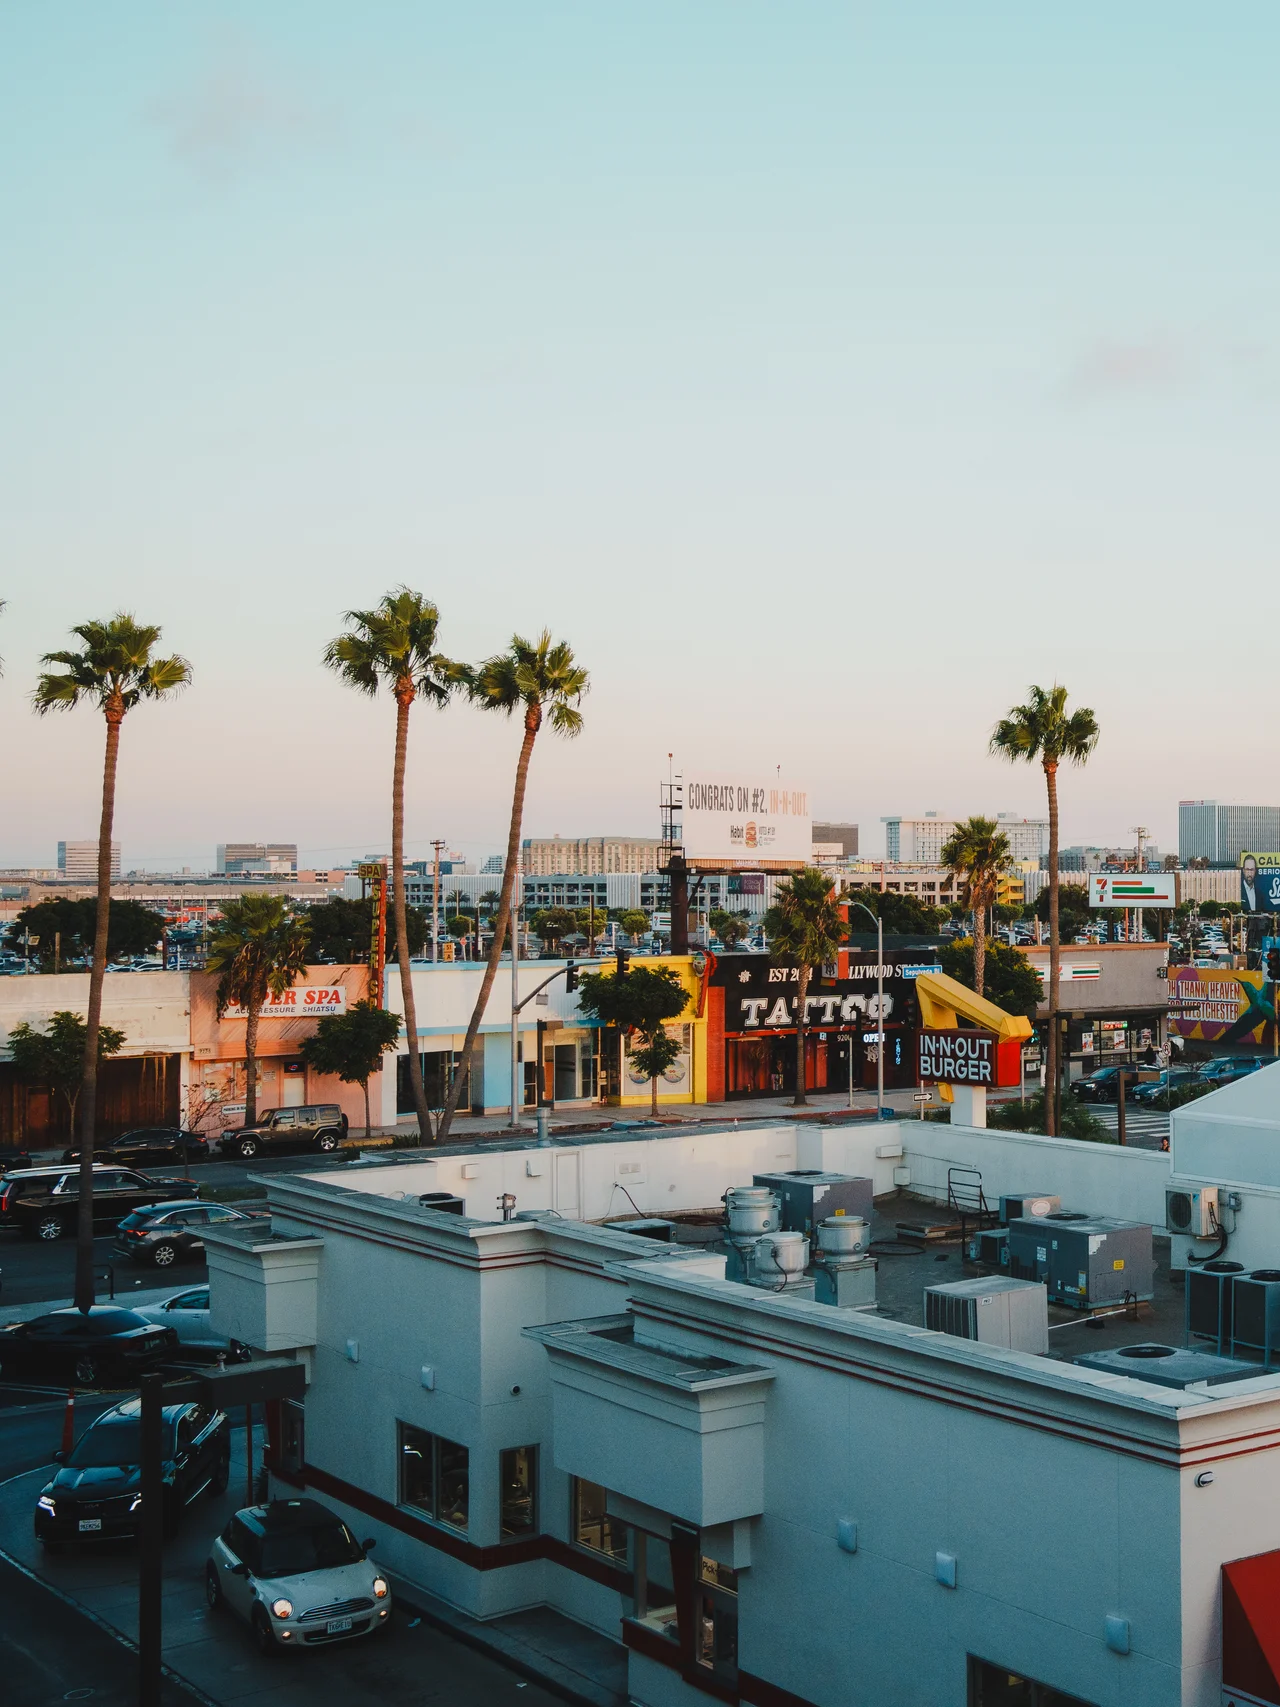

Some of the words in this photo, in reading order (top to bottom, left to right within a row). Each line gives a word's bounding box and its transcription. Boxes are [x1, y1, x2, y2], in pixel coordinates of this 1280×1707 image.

[688, 783, 734, 812] CONGRATS
[737, 786, 749, 813] ON
[751, 788, 768, 816] #2,
[359, 865, 380, 877] SPA
[768, 968, 789, 982] EST
[905, 968, 933, 978] Sepulveda
[304, 989, 342, 1005] SPA
[1179, 980, 1207, 1000] THANK
[1209, 981, 1240, 1001] HEAVEN
[740, 992, 894, 1027] TATTOO
[1183, 1000, 1240, 1021] WESTCHESTER
[919, 1055, 992, 1082] BURGER
